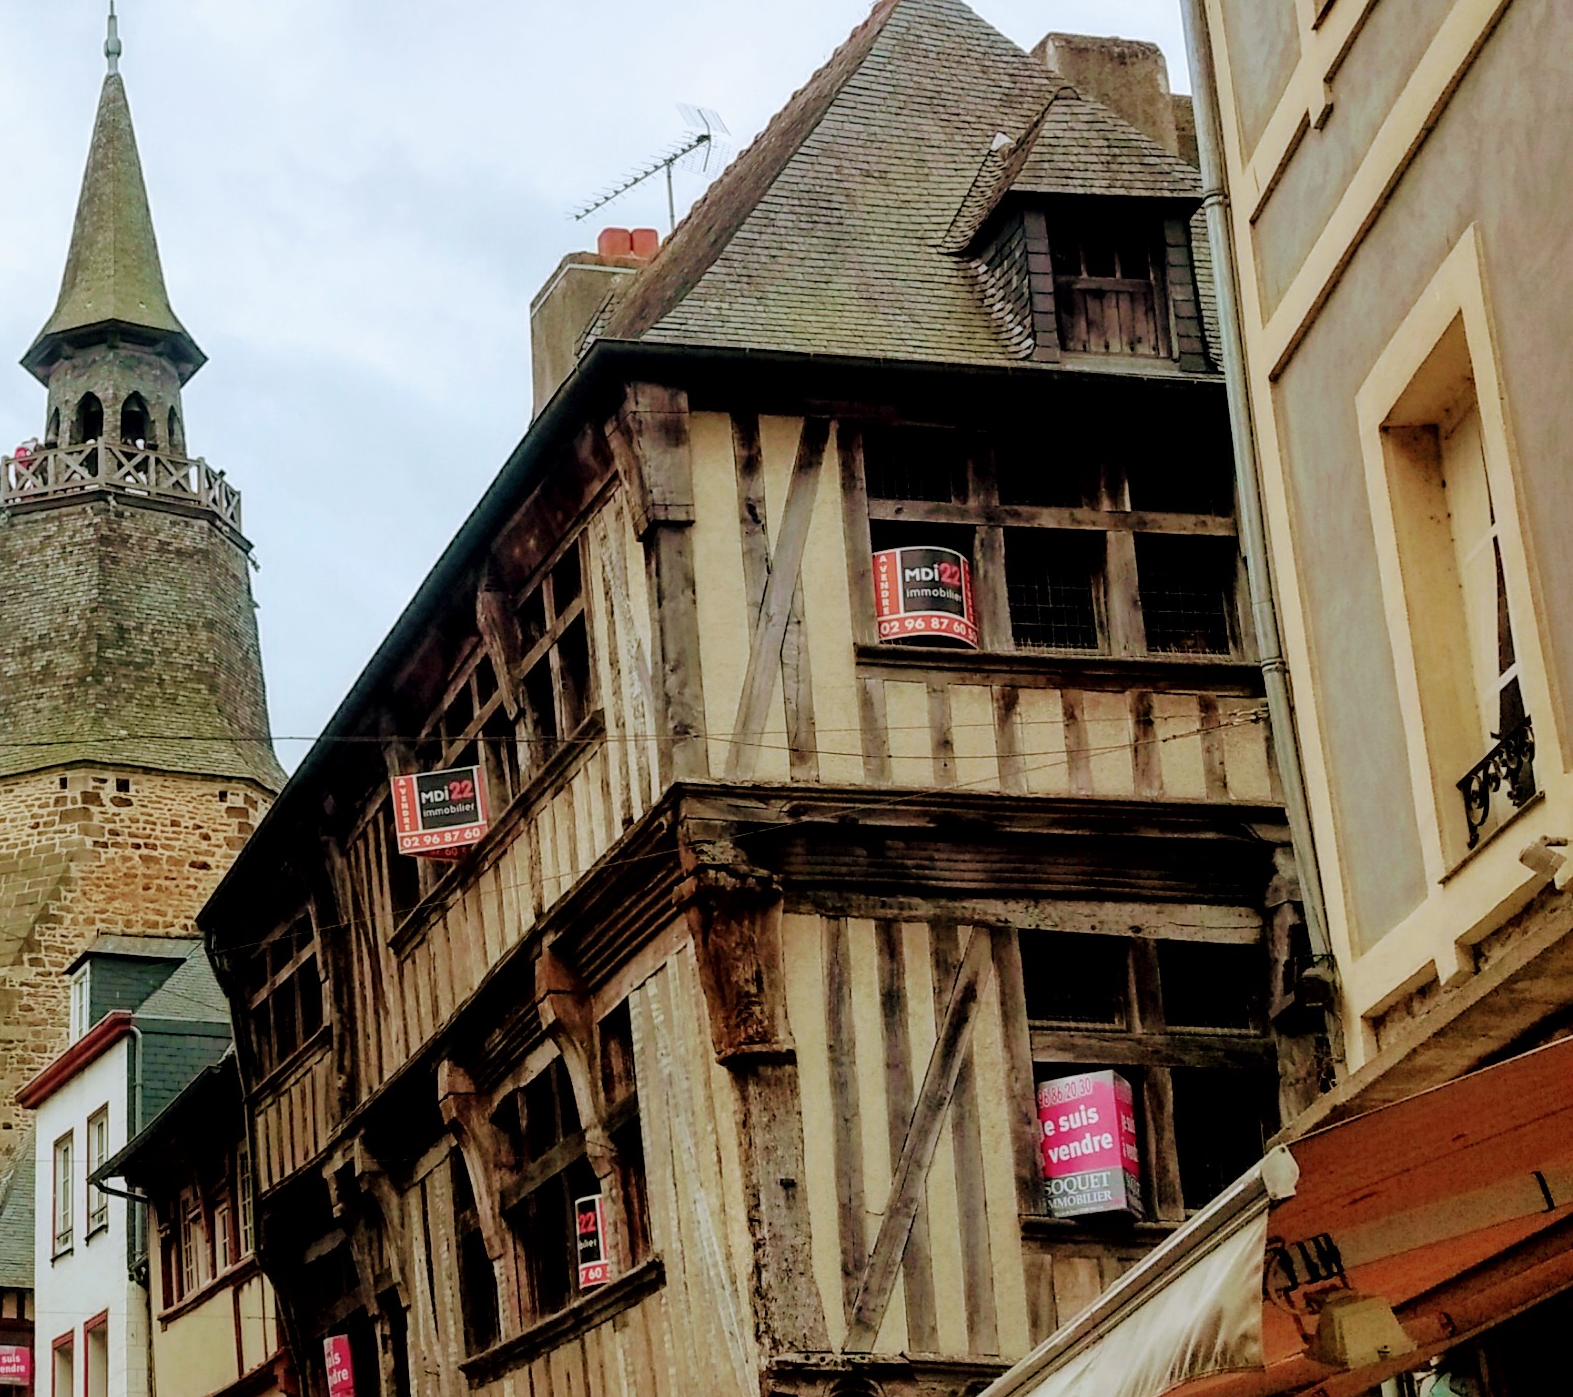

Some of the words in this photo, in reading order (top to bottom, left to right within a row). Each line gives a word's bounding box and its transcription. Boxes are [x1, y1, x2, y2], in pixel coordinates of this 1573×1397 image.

[880, 622, 900, 634] 02
[904, 618, 925, 630] 96
[930, 617, 948, 630] 87
[953, 622, 967, 635] 60
[422, 803, 475, 818] immobilier
[402, 837, 420, 848] 02
[423, 835, 440, 845] 96
[444, 831, 459, 842] 87
[464, 828, 481, 839] 60
[1065, 1082, 1077, 1099] 20
[1079, 1078, 1091, 1094] 30
[1059, 1105, 1099, 1131] suis
[1048, 1132, 1114, 1163] vendre
[588, 1267, 602, 1280] 60
